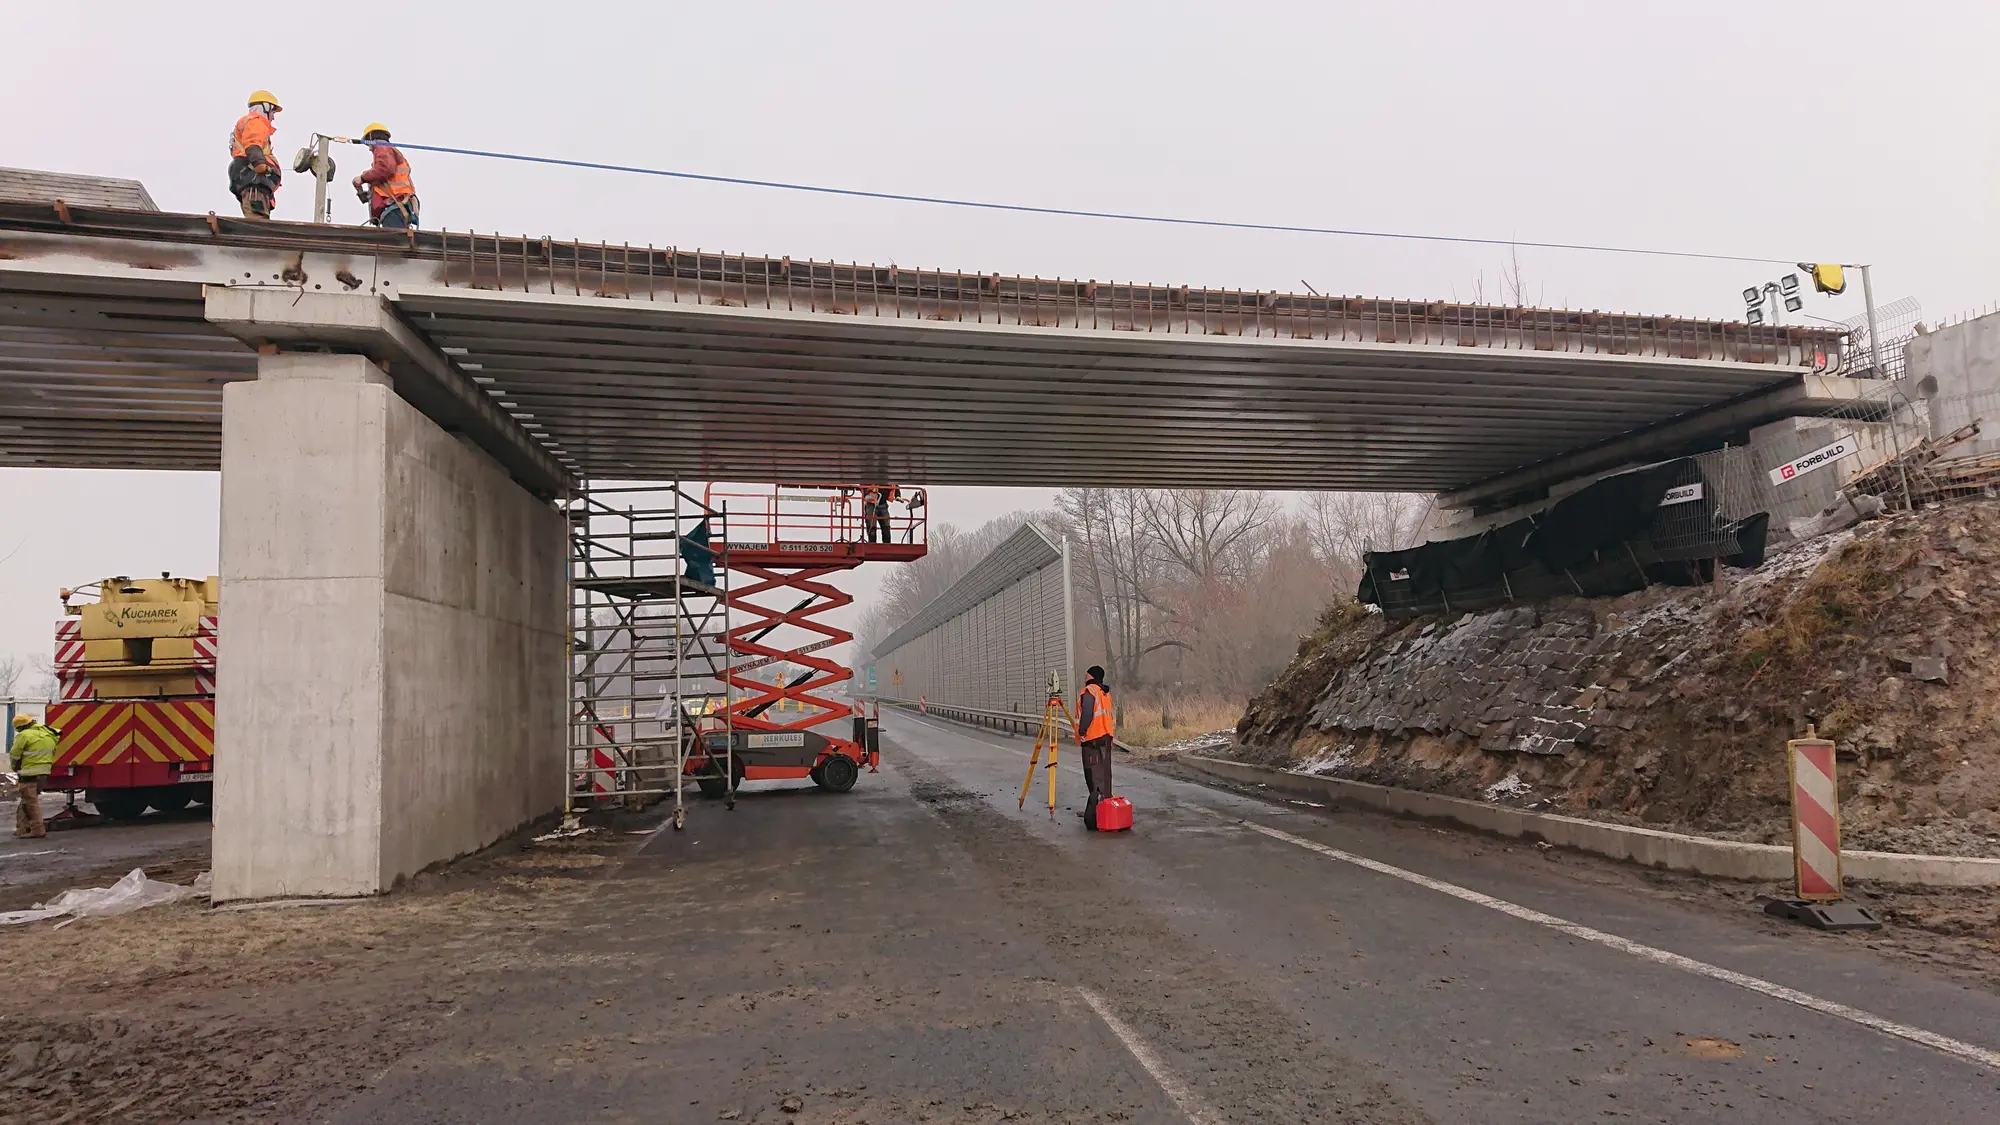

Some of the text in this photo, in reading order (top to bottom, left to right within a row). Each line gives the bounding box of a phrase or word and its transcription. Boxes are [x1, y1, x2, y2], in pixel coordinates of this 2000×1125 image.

[1796, 445, 1844, 470] FORBUILD
[121, 607, 178, 619] KUCHAREK
[736, 657, 769, 672] WYNAJEM
[764, 734, 802, 742] HERKULES
